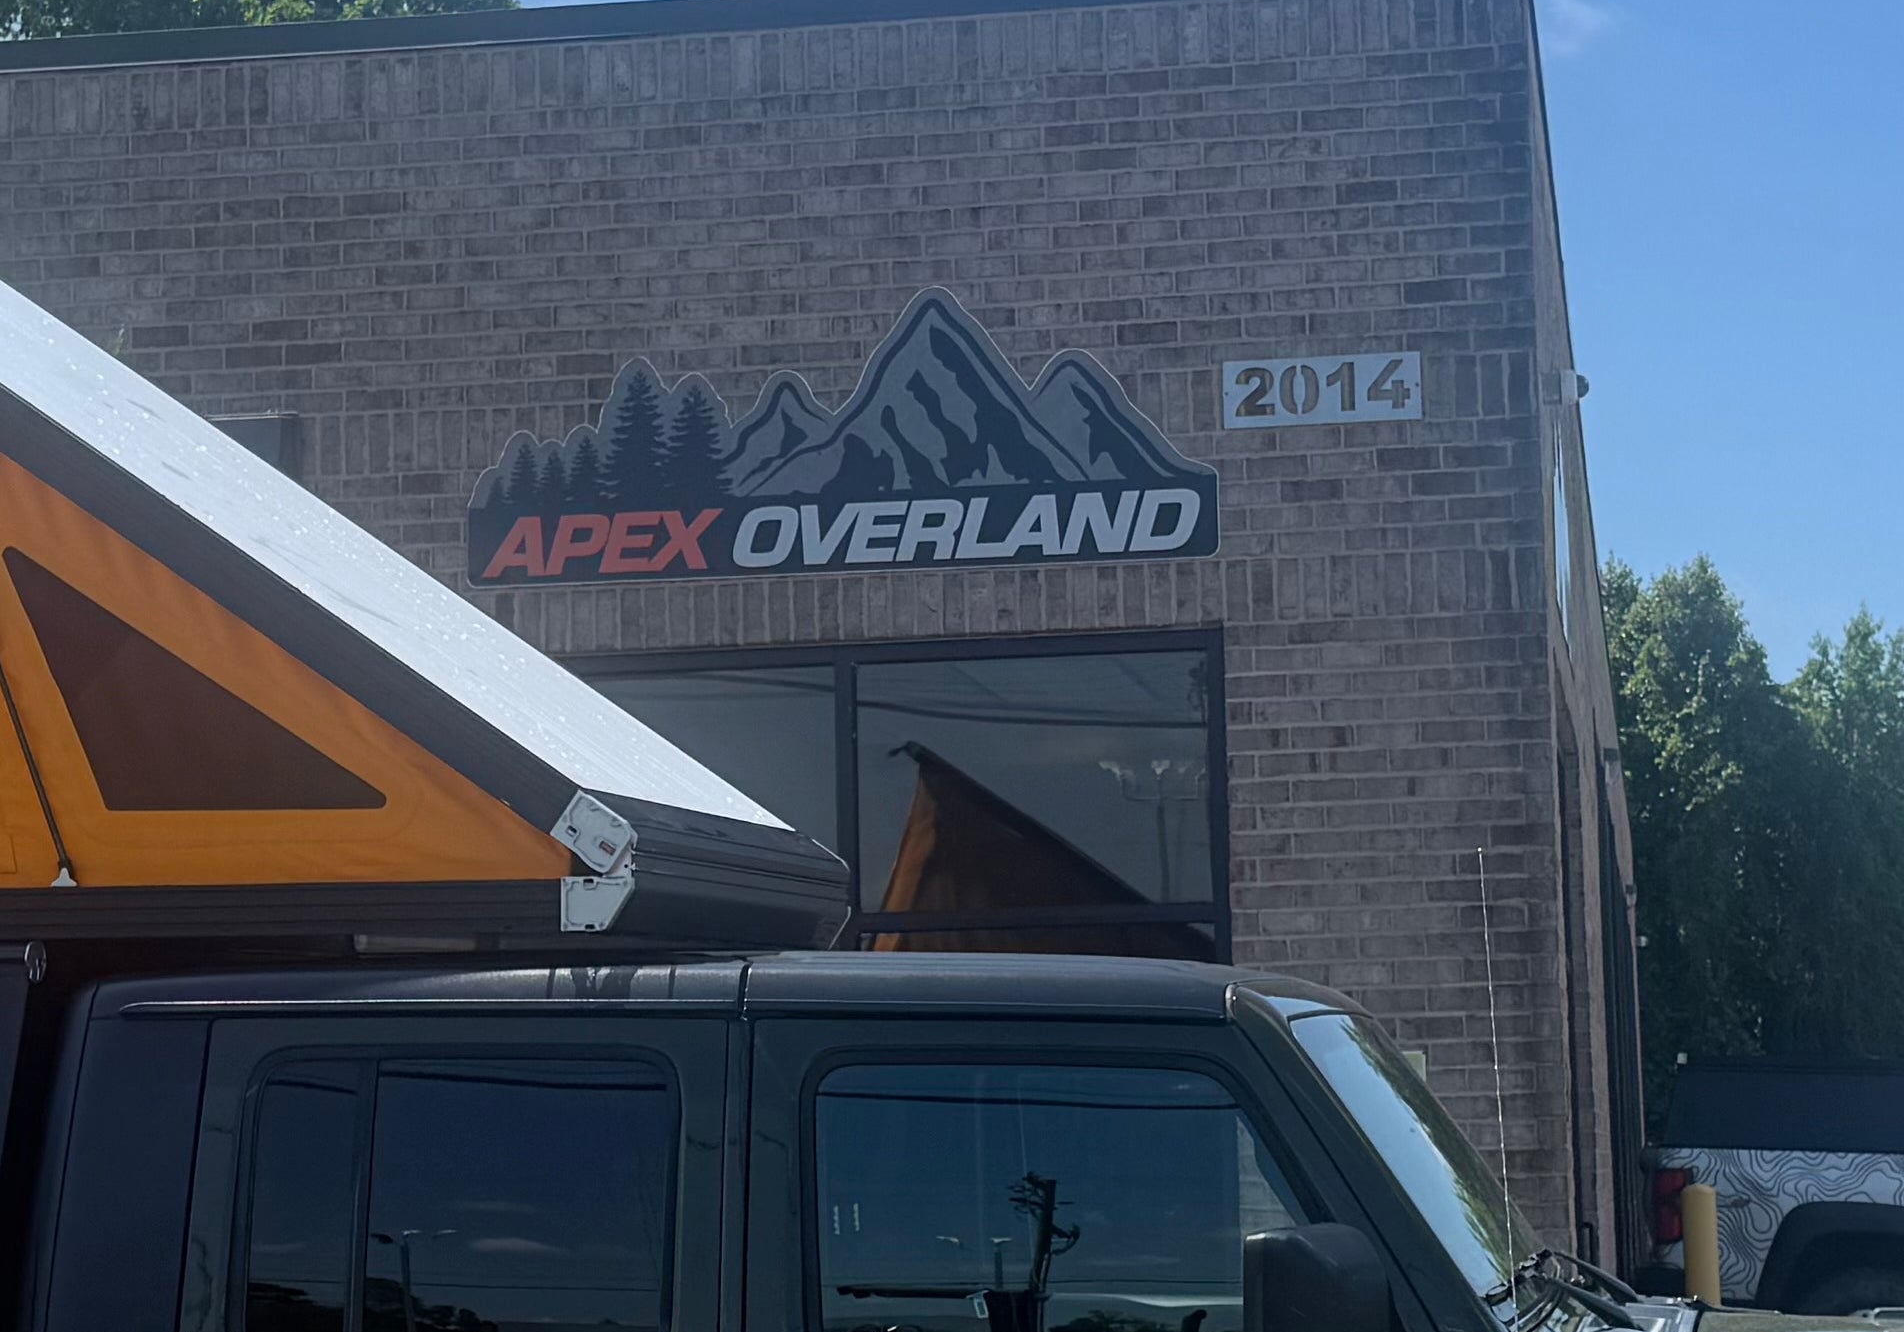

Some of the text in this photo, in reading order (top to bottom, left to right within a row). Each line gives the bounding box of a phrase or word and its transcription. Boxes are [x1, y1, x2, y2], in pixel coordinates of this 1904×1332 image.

[1234, 358, 1411, 418] 2014
[481, 488, 1201, 579] APEX OVERLAND
